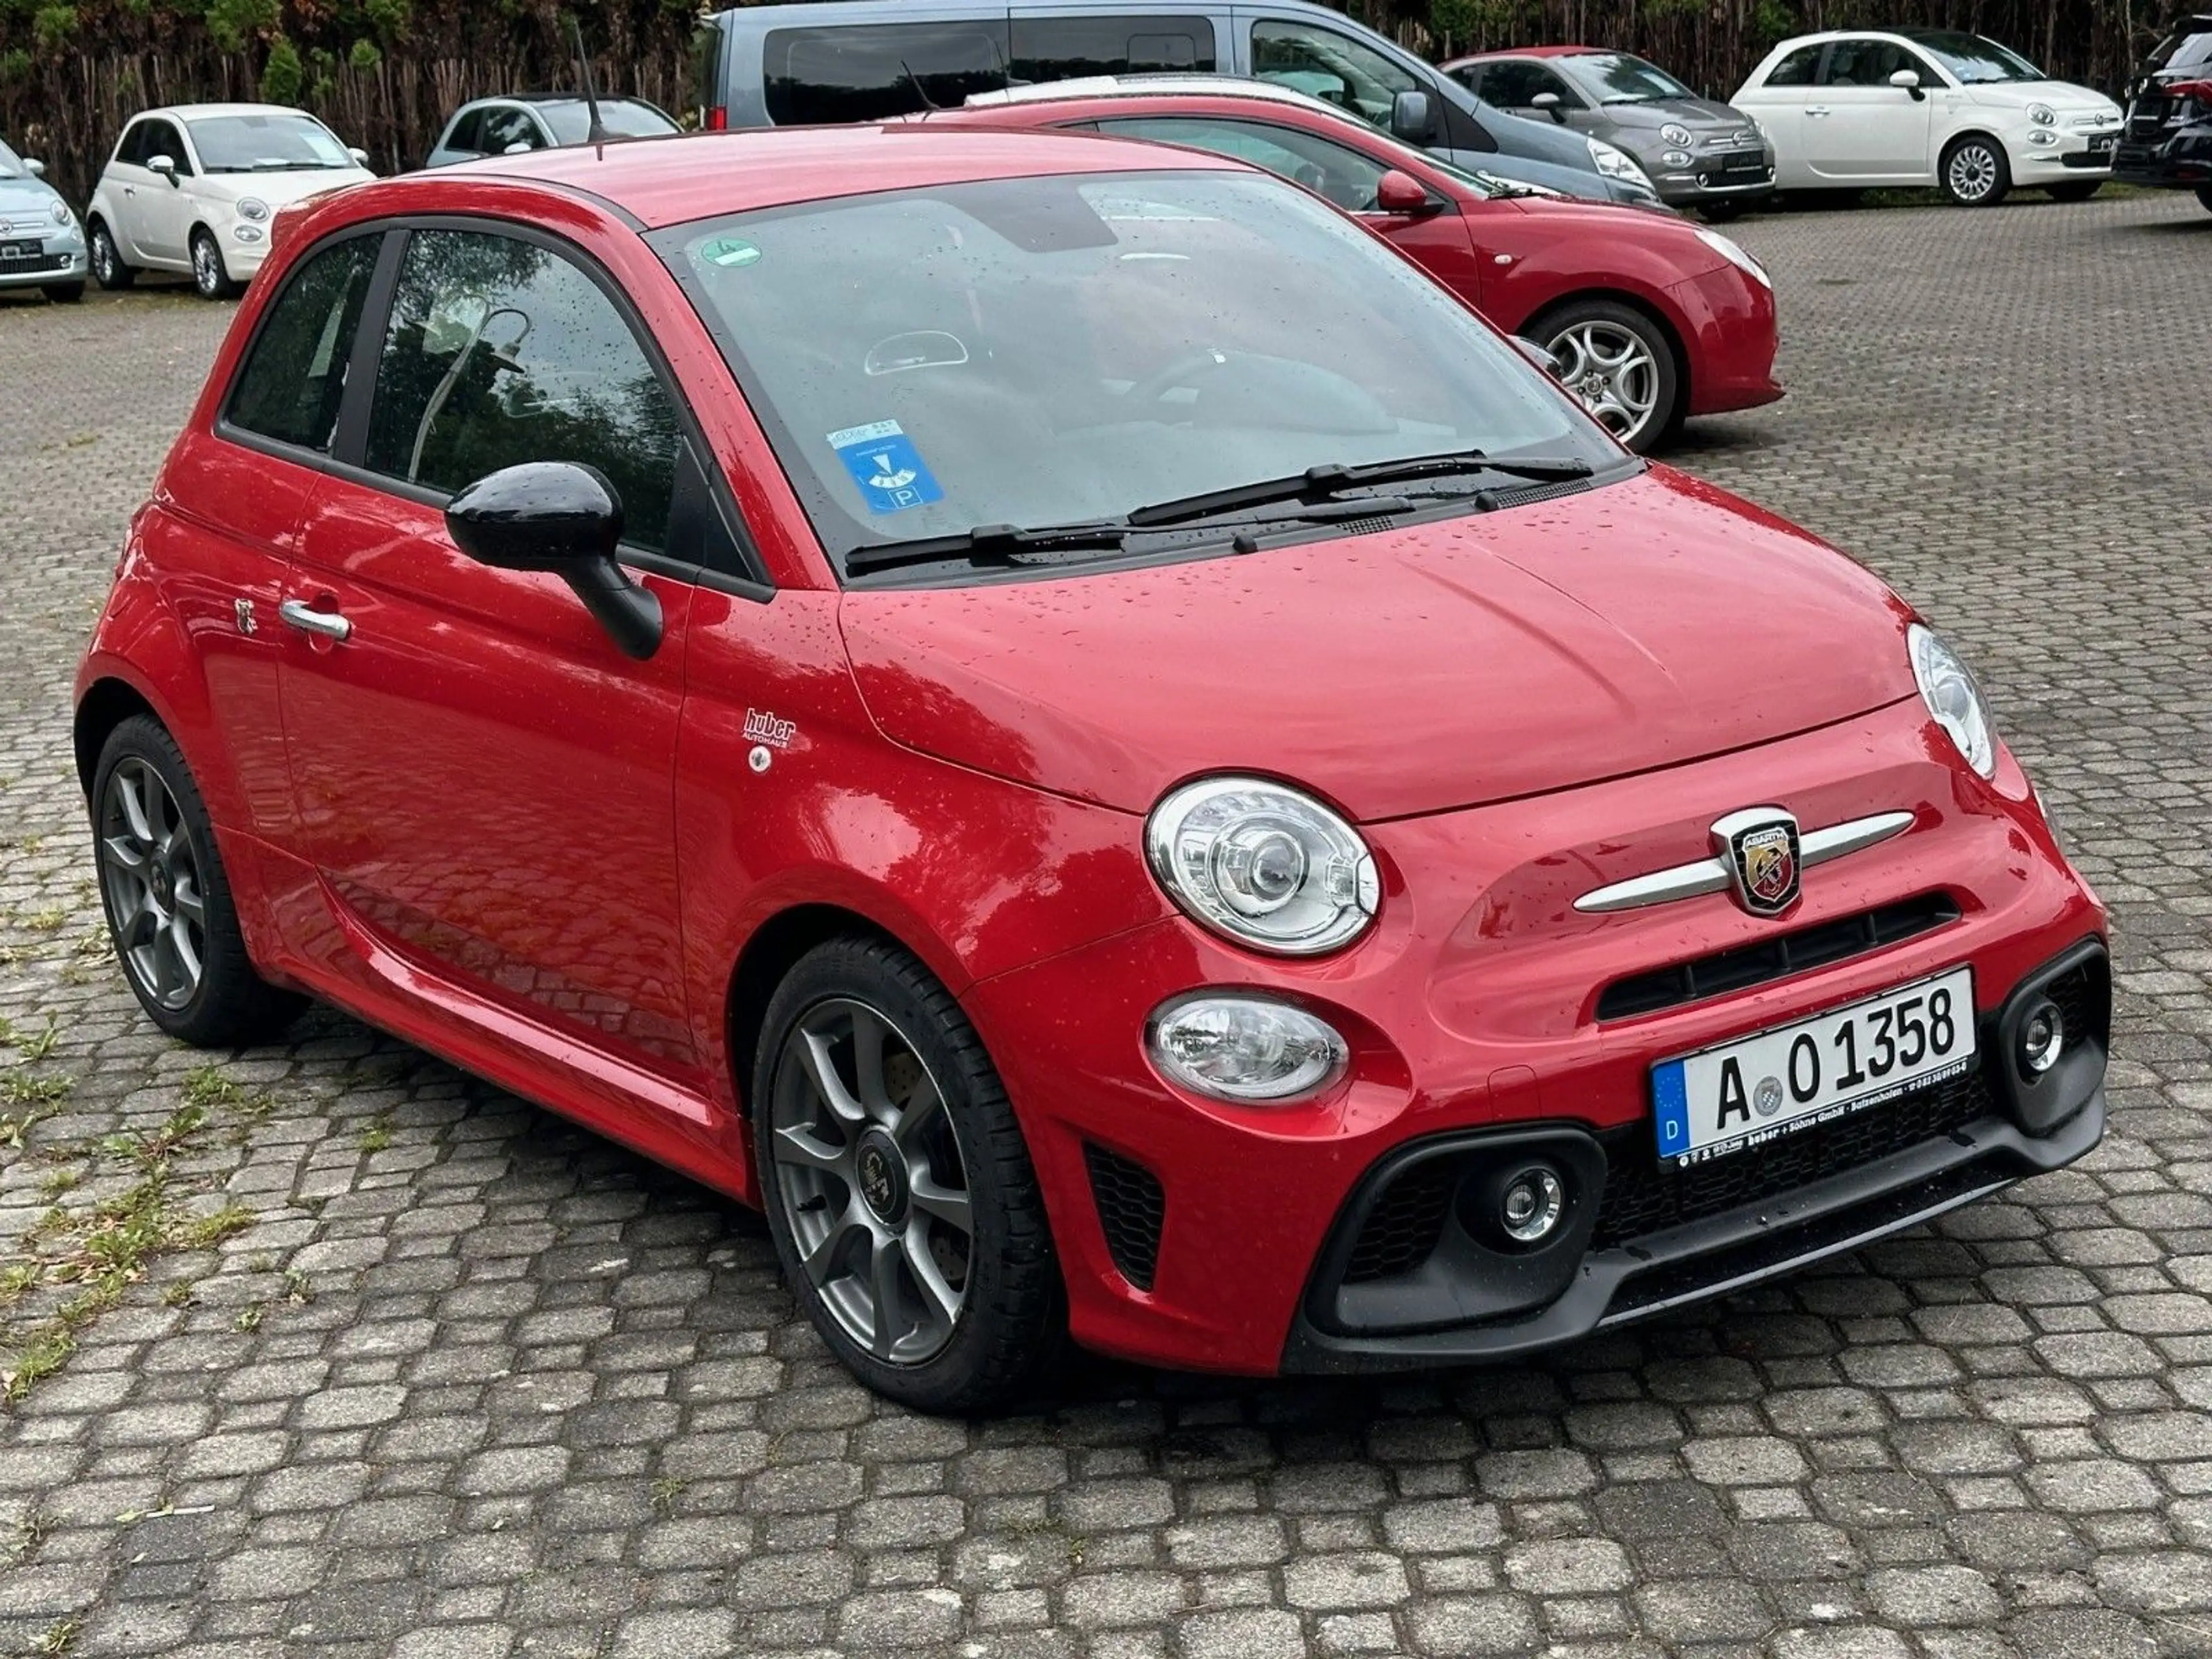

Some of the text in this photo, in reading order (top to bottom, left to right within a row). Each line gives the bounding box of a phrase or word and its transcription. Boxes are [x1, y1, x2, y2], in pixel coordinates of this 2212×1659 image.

[895, 490, 914, 506] P
[744, 707, 796, 740] huber
[742, 732, 787, 748] AUTOHAUS
[1717, 1055, 1751, 1130] A
[1666, 1119, 1679, 1141] D
